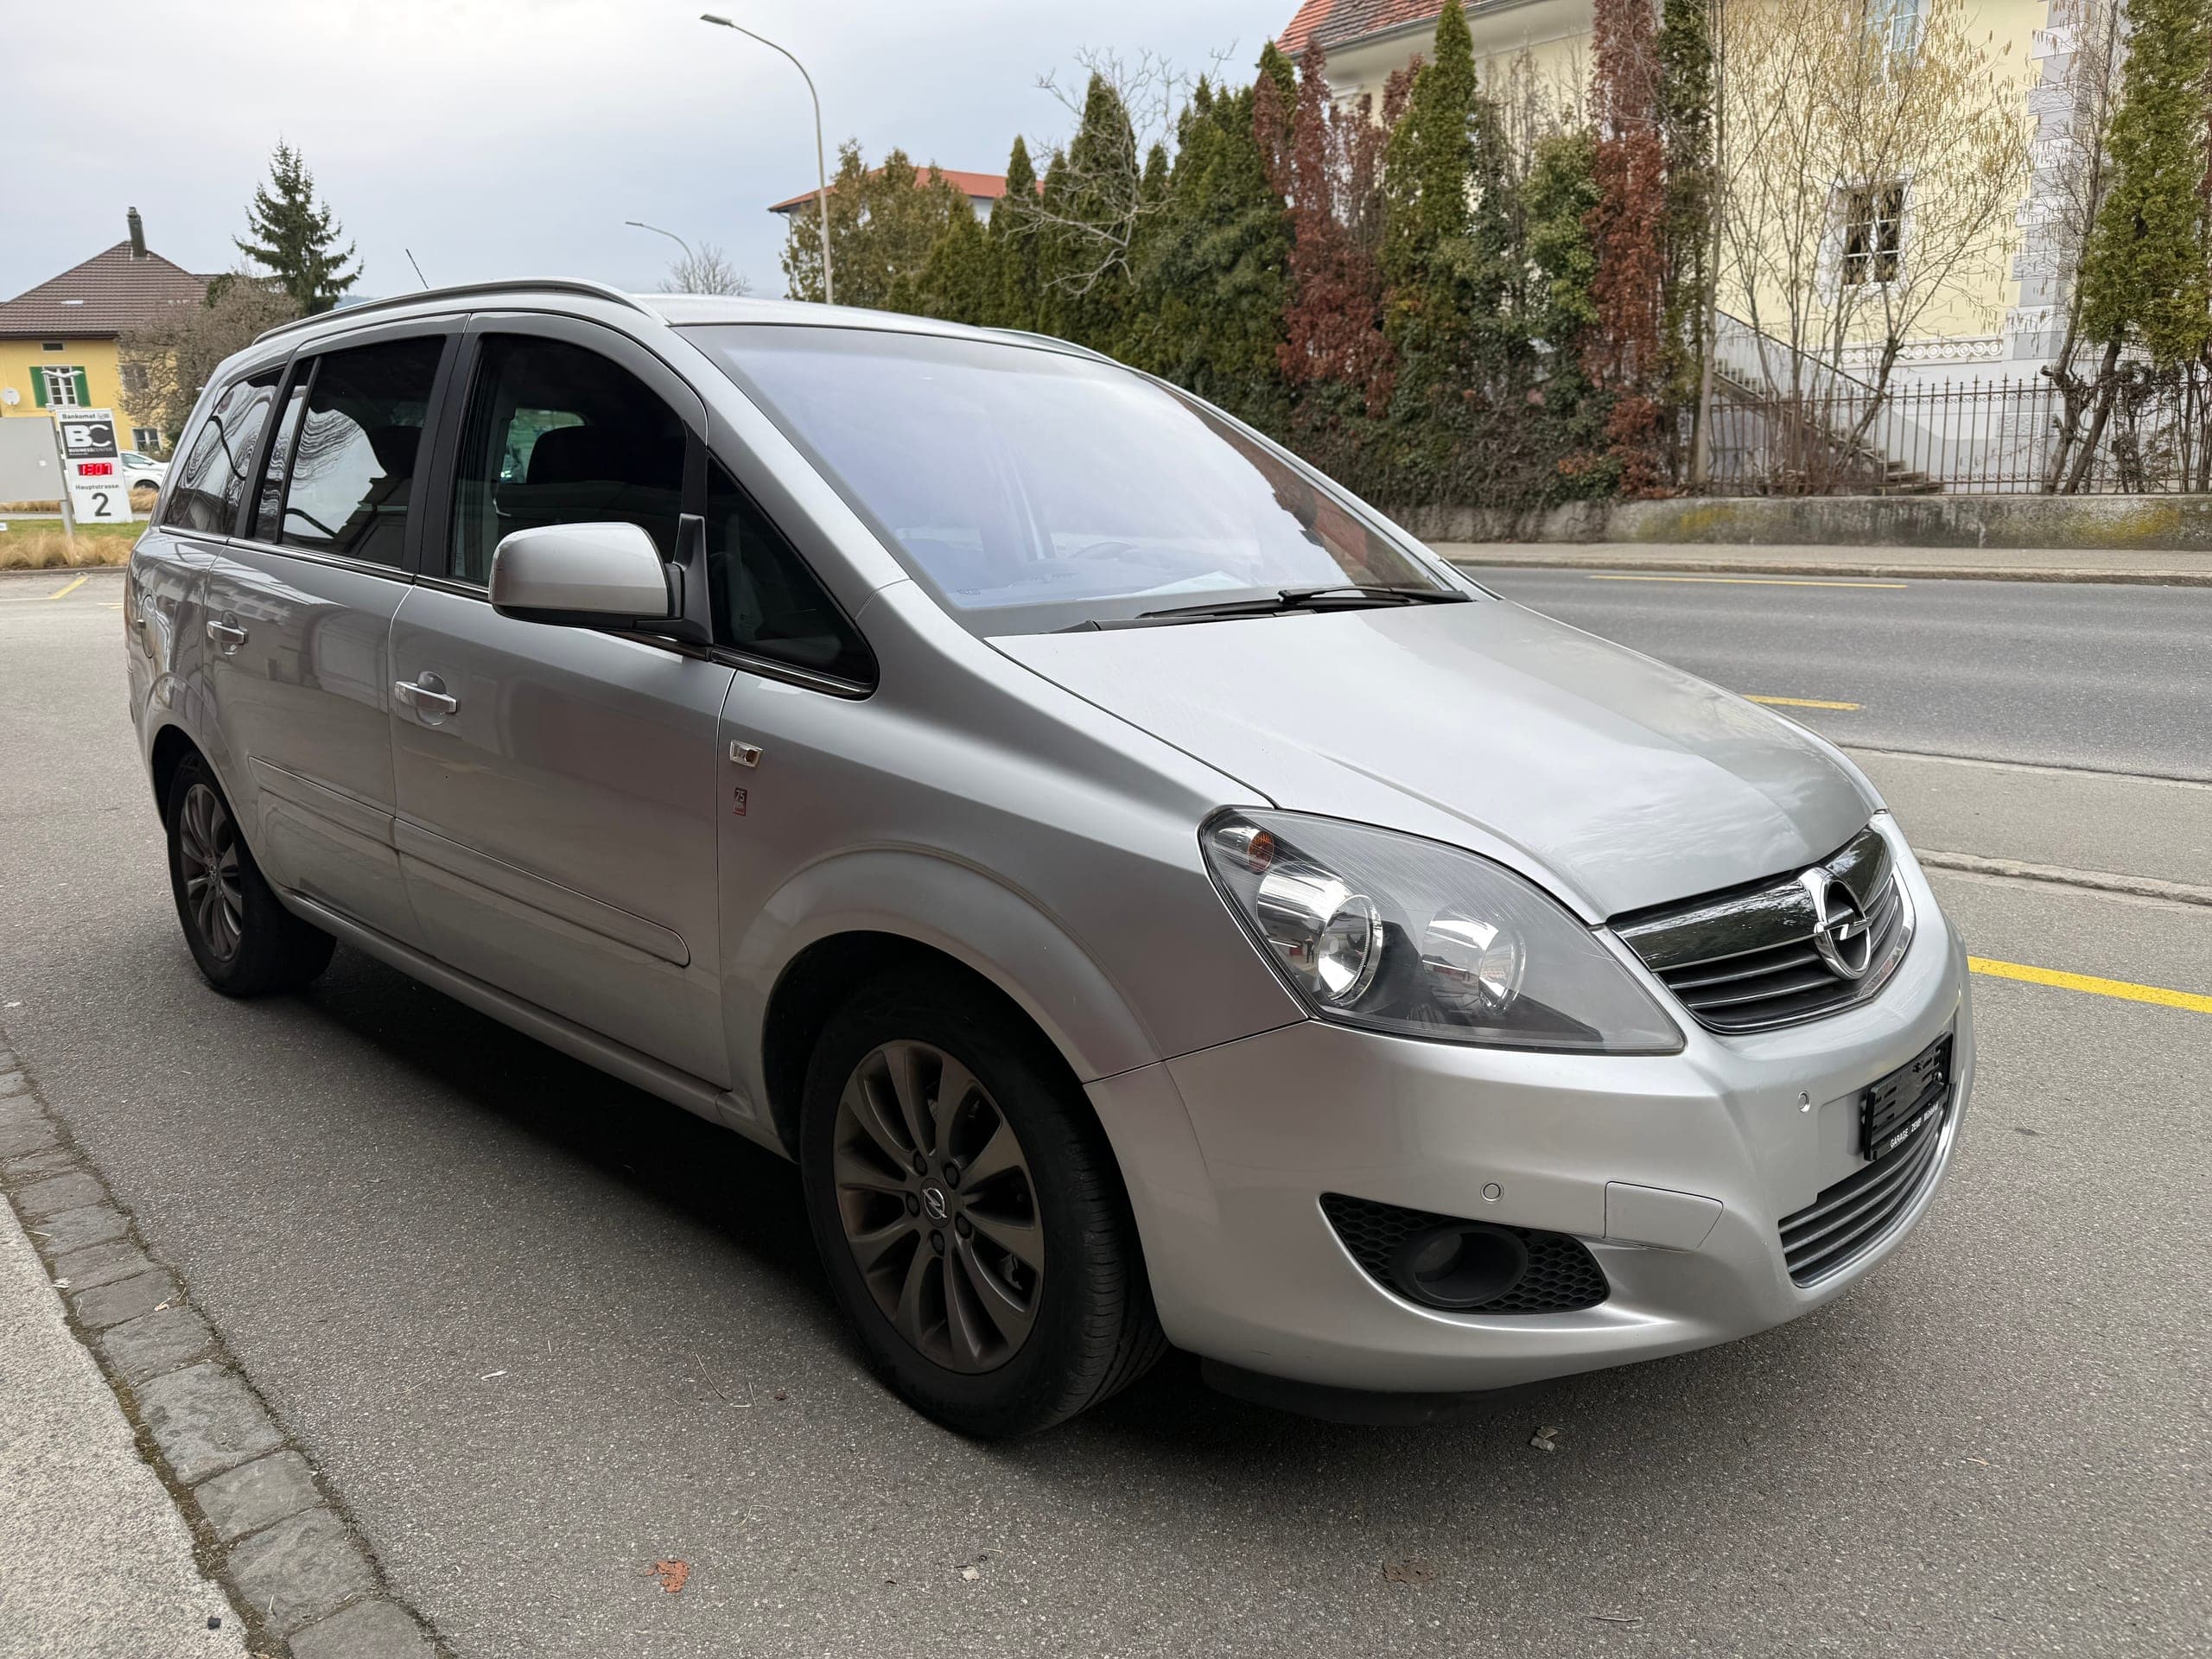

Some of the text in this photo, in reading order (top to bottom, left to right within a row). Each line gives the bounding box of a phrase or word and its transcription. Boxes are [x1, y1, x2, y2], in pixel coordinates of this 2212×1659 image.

[64, 424, 111, 448] BC
[92, 493, 111, 517] 2
[1891, 1128, 1908, 1147] GARAGE
